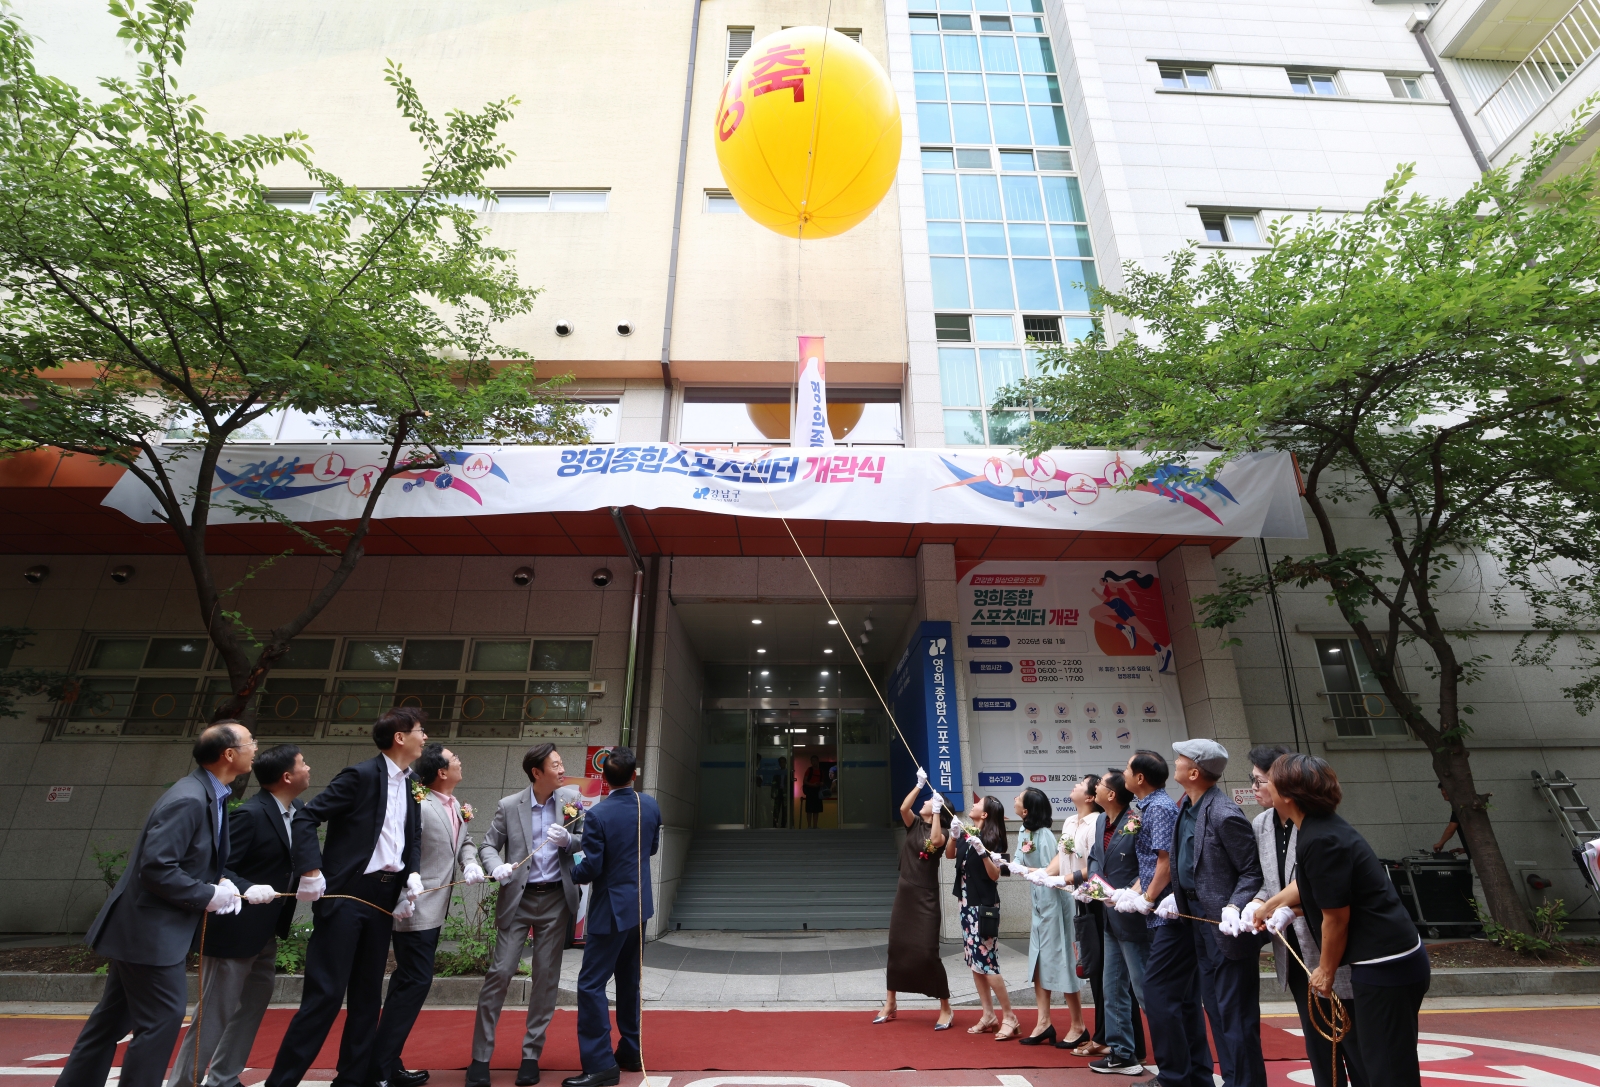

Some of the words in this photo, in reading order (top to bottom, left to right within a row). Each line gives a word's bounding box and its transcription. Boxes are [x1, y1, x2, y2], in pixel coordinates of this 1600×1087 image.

[557, 446, 800, 484] 영희종합스포츠센터
[801, 456, 886, 484] 개관식
[711, 489, 741, 498] 강남구
[973, 589, 1034, 606] 영희종합
[971, 608, 1046, 625] 스포츠센터
[1048, 609, 1080, 625] 개관
[932, 658, 952, 791] 영희종합스포츠센터
[989, 775, 1012, 783] 접수기간
[1062, 774, 1077, 782] 20일
